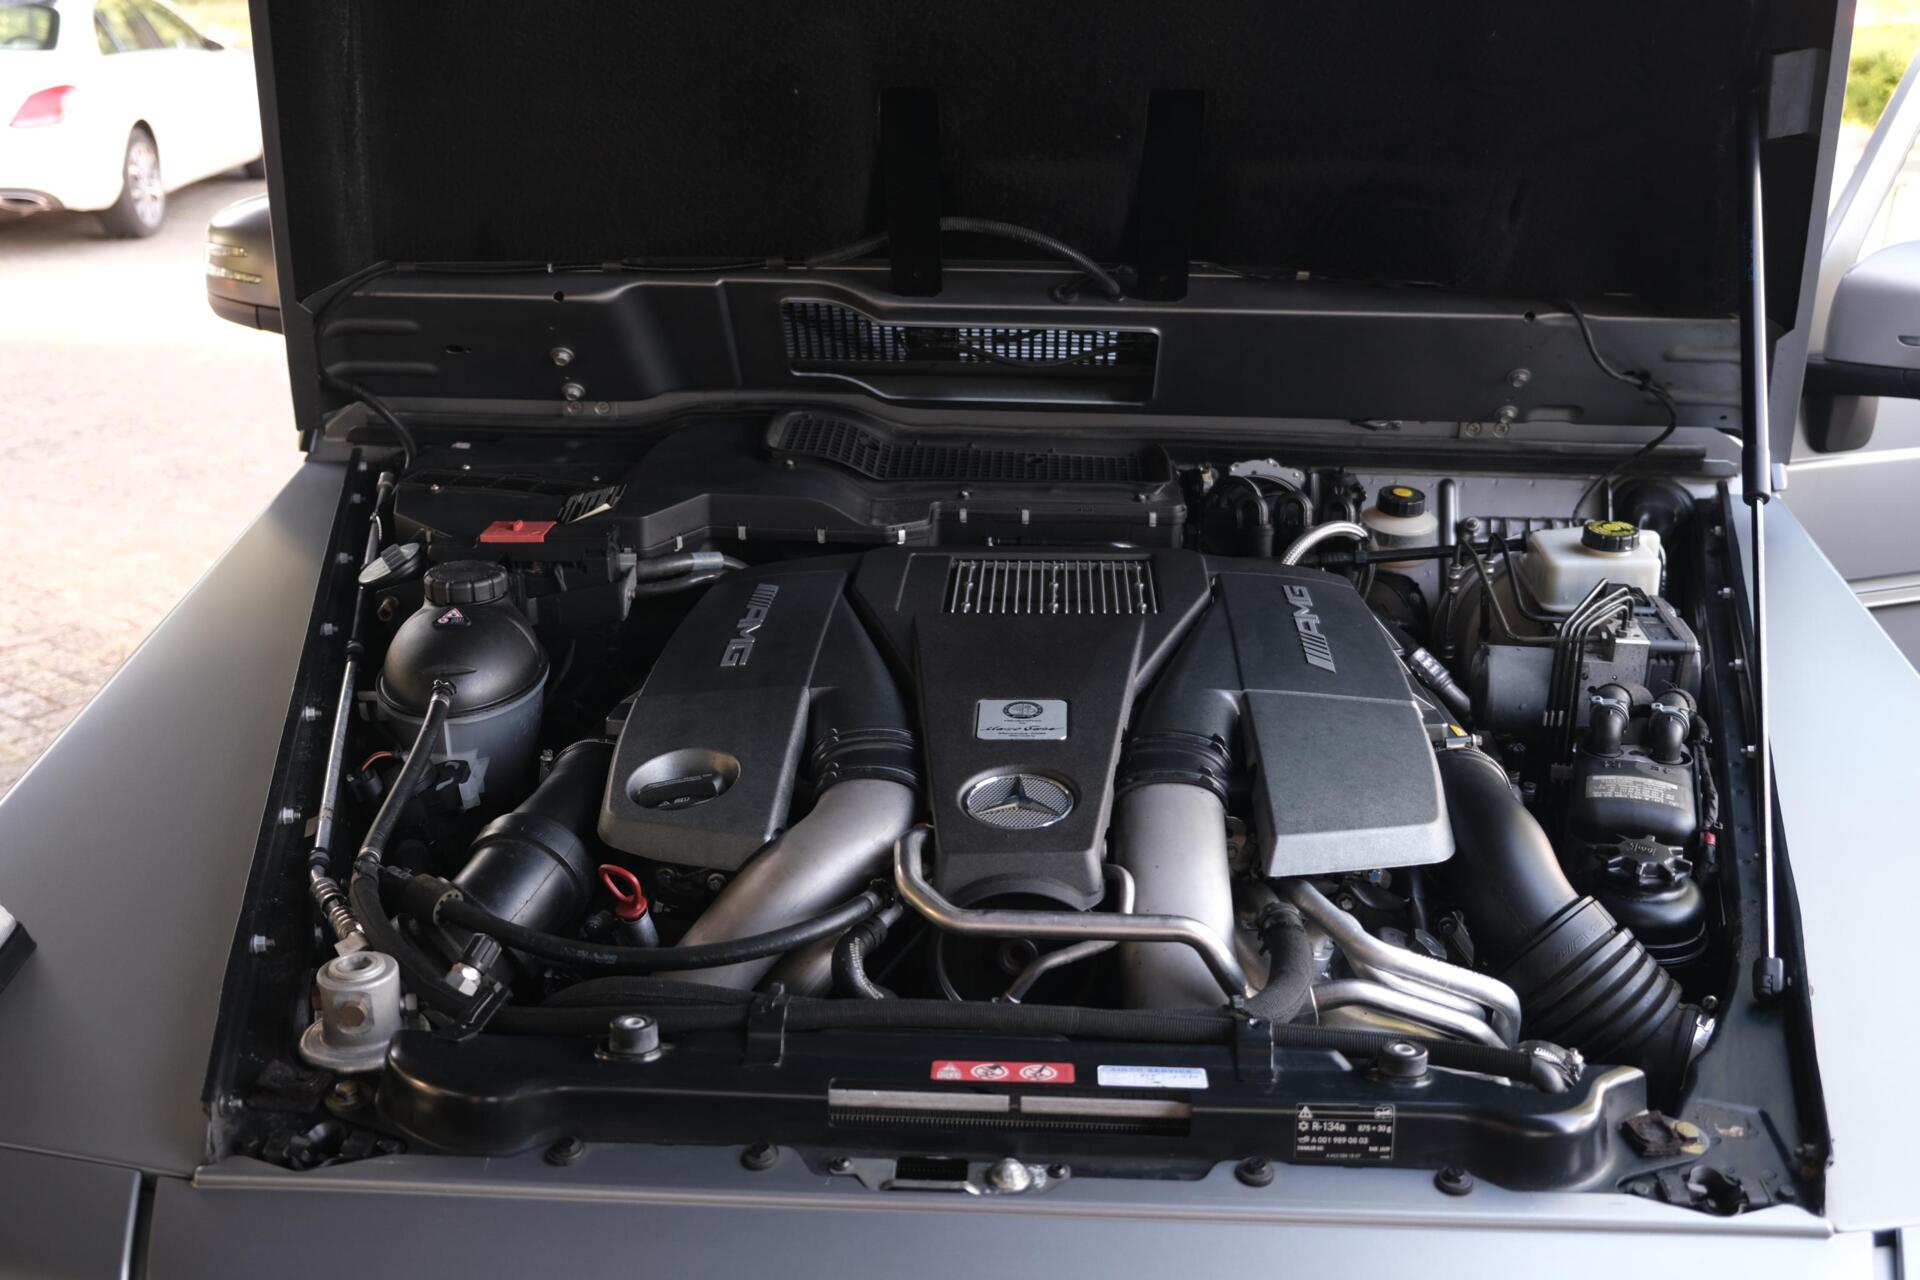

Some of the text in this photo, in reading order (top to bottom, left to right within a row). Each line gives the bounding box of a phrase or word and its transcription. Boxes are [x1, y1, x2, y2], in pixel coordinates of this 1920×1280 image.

[720, 584, 779, 667] AMG
[1283, 585, 1336, 673] AMG
[1311, 1136, 1317, 1144] A
[1317, 1136, 1331, 1144] 001
[1312, 1121, 1346, 1131] R-134a
